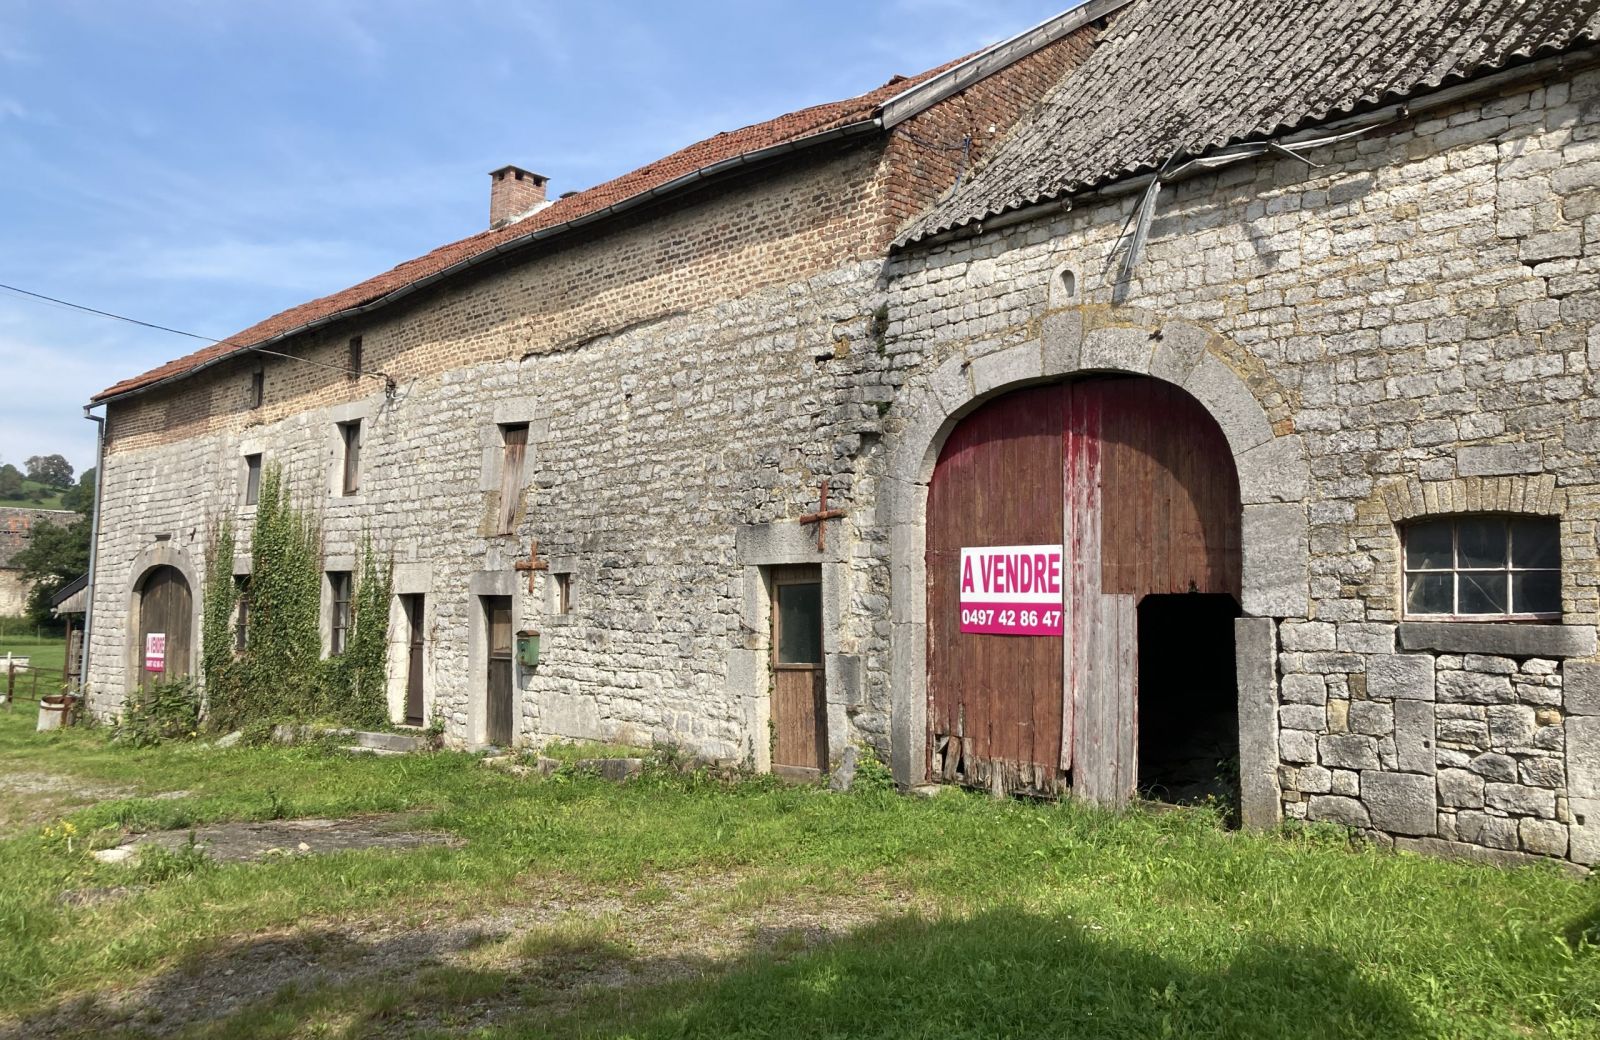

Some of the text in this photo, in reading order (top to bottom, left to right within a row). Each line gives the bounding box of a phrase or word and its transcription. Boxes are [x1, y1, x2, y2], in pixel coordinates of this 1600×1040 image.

[962, 553, 1060, 593] A VENDRE
[962, 609, 1061, 627] 0497 42 86 47
